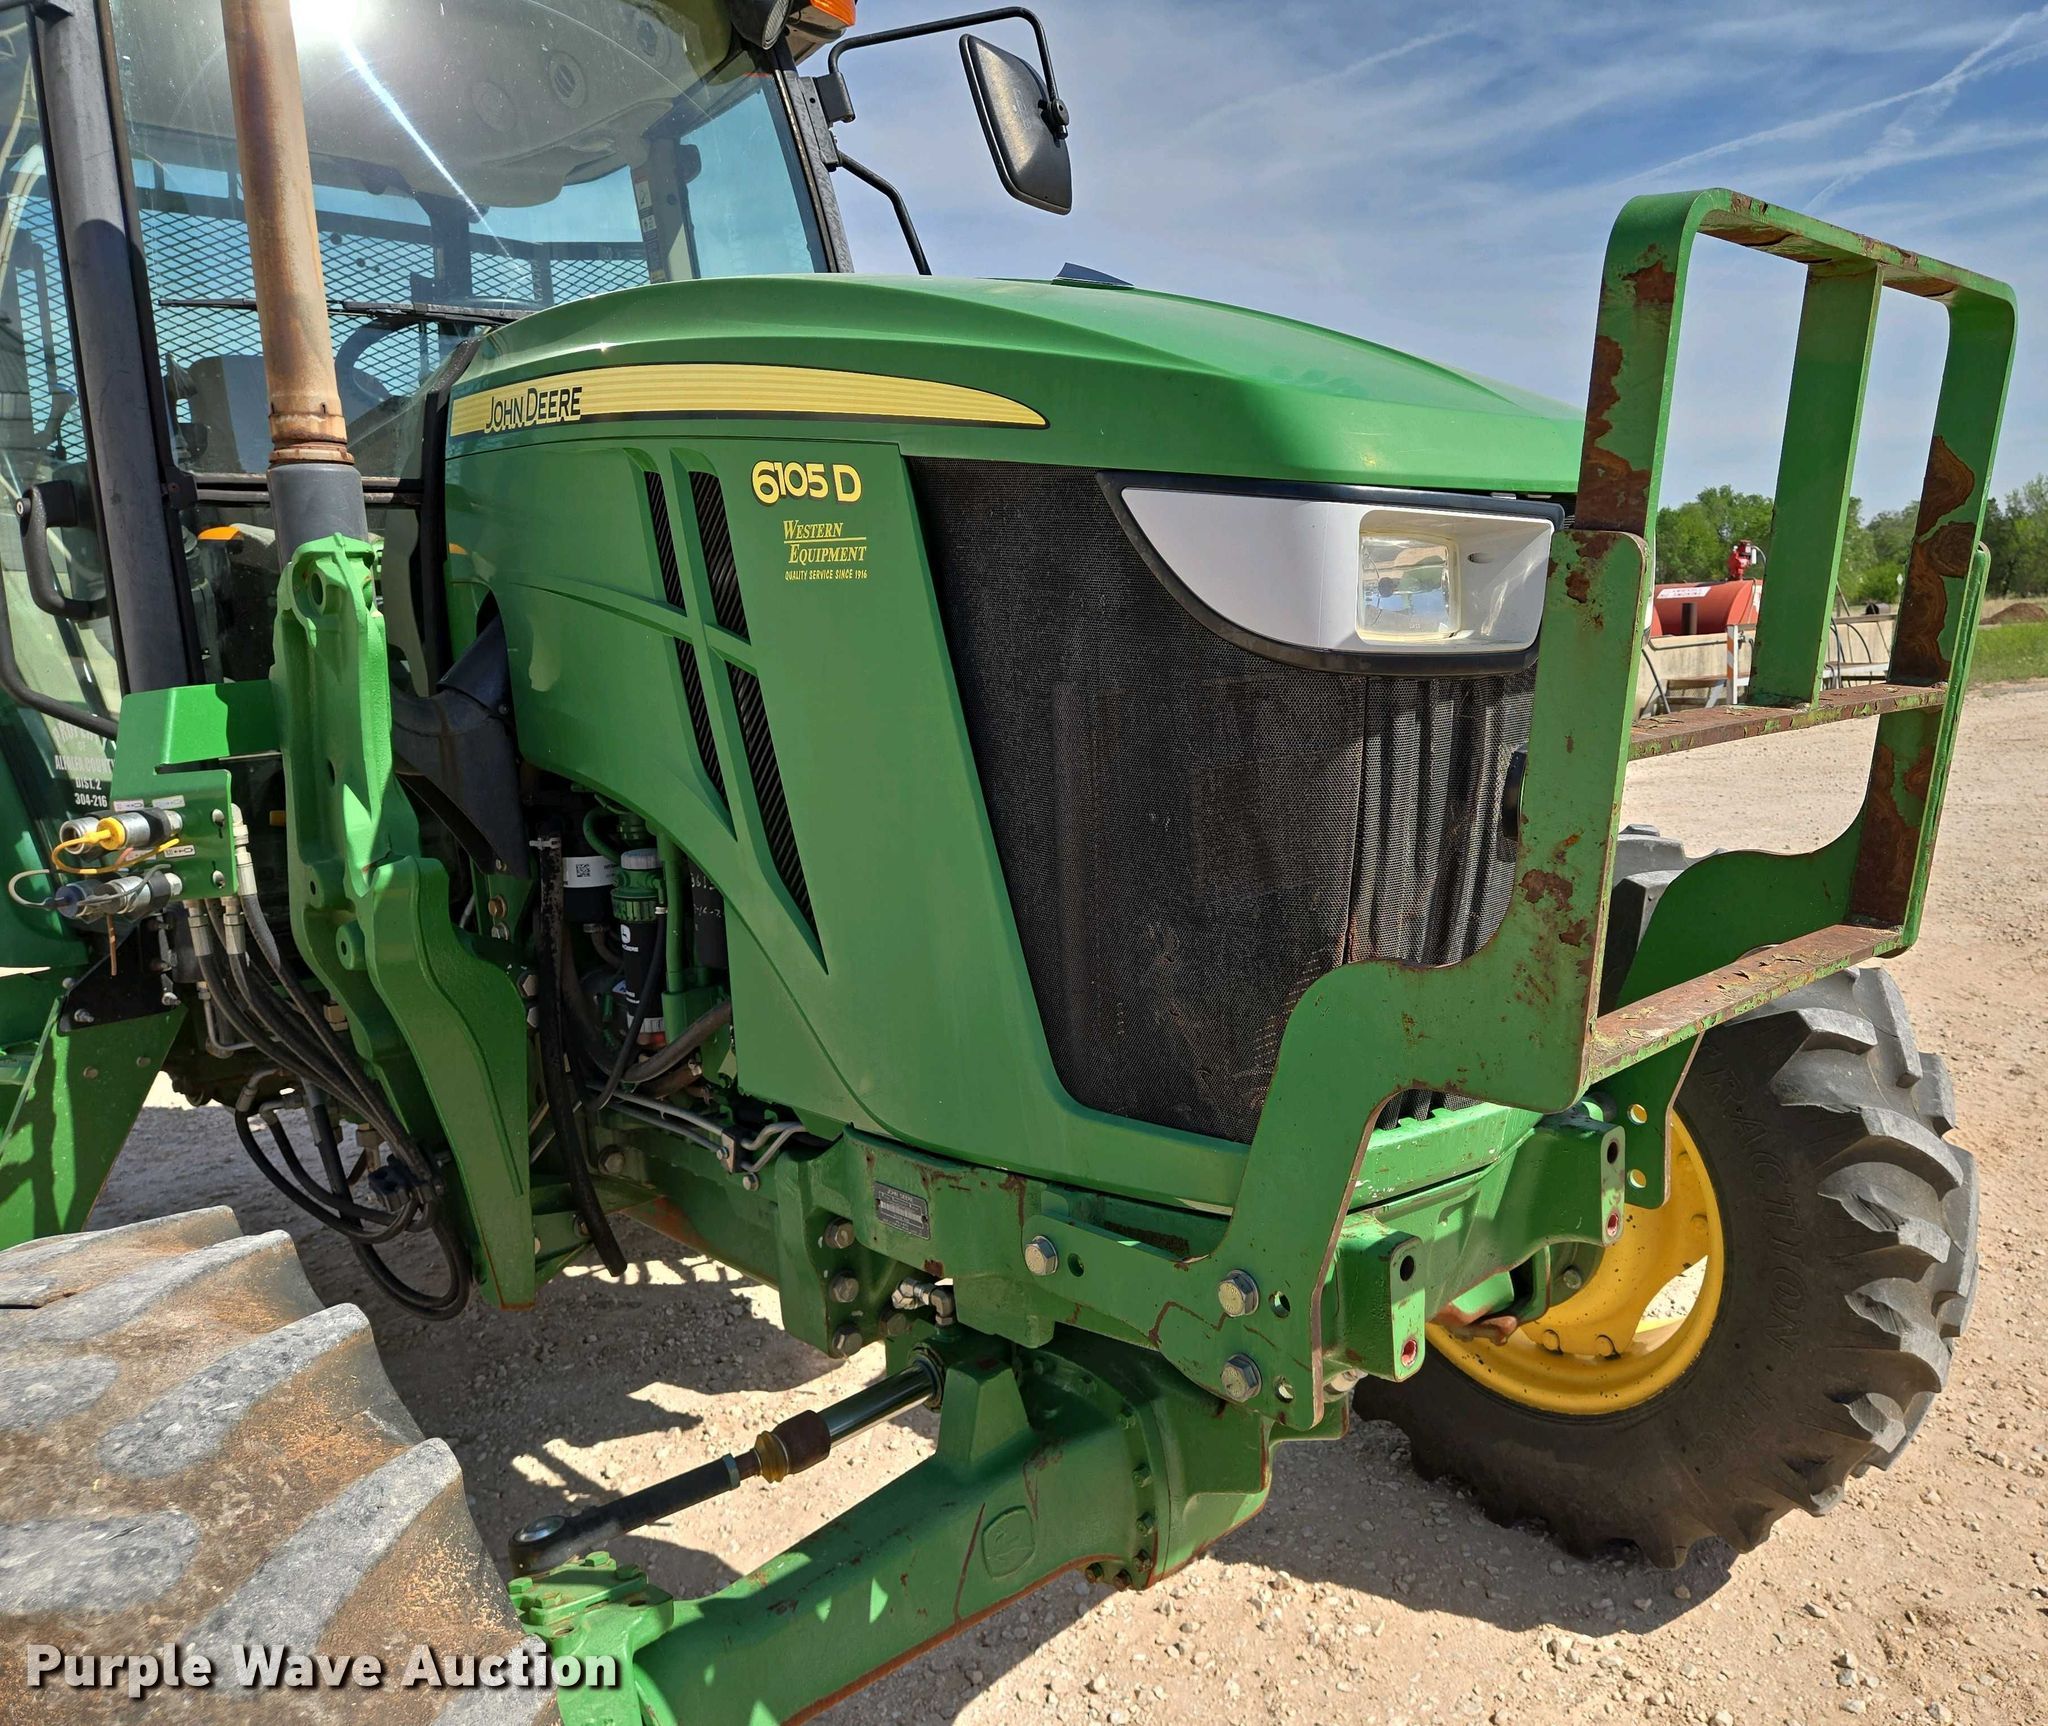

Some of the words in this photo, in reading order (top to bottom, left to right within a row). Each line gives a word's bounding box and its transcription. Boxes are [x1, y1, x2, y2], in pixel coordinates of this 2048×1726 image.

[485, 395, 524, 433] JOHN
[525, 386, 582, 425] DEERE
[752, 460, 829, 506] 6105
[832, 463, 863, 503] D
[783, 519, 844, 539] WESTERN
[788, 543, 867, 566] EQUIPMENT
[785, 570, 807, 581] QUALITY
[809, 569, 833, 580] SERVICE
[835, 568, 853, 579] SINCE
[75, 777, 95, 790] DIST.
[95, 778, 102, 790] 2
[74, 792, 108, 808] 304-216
